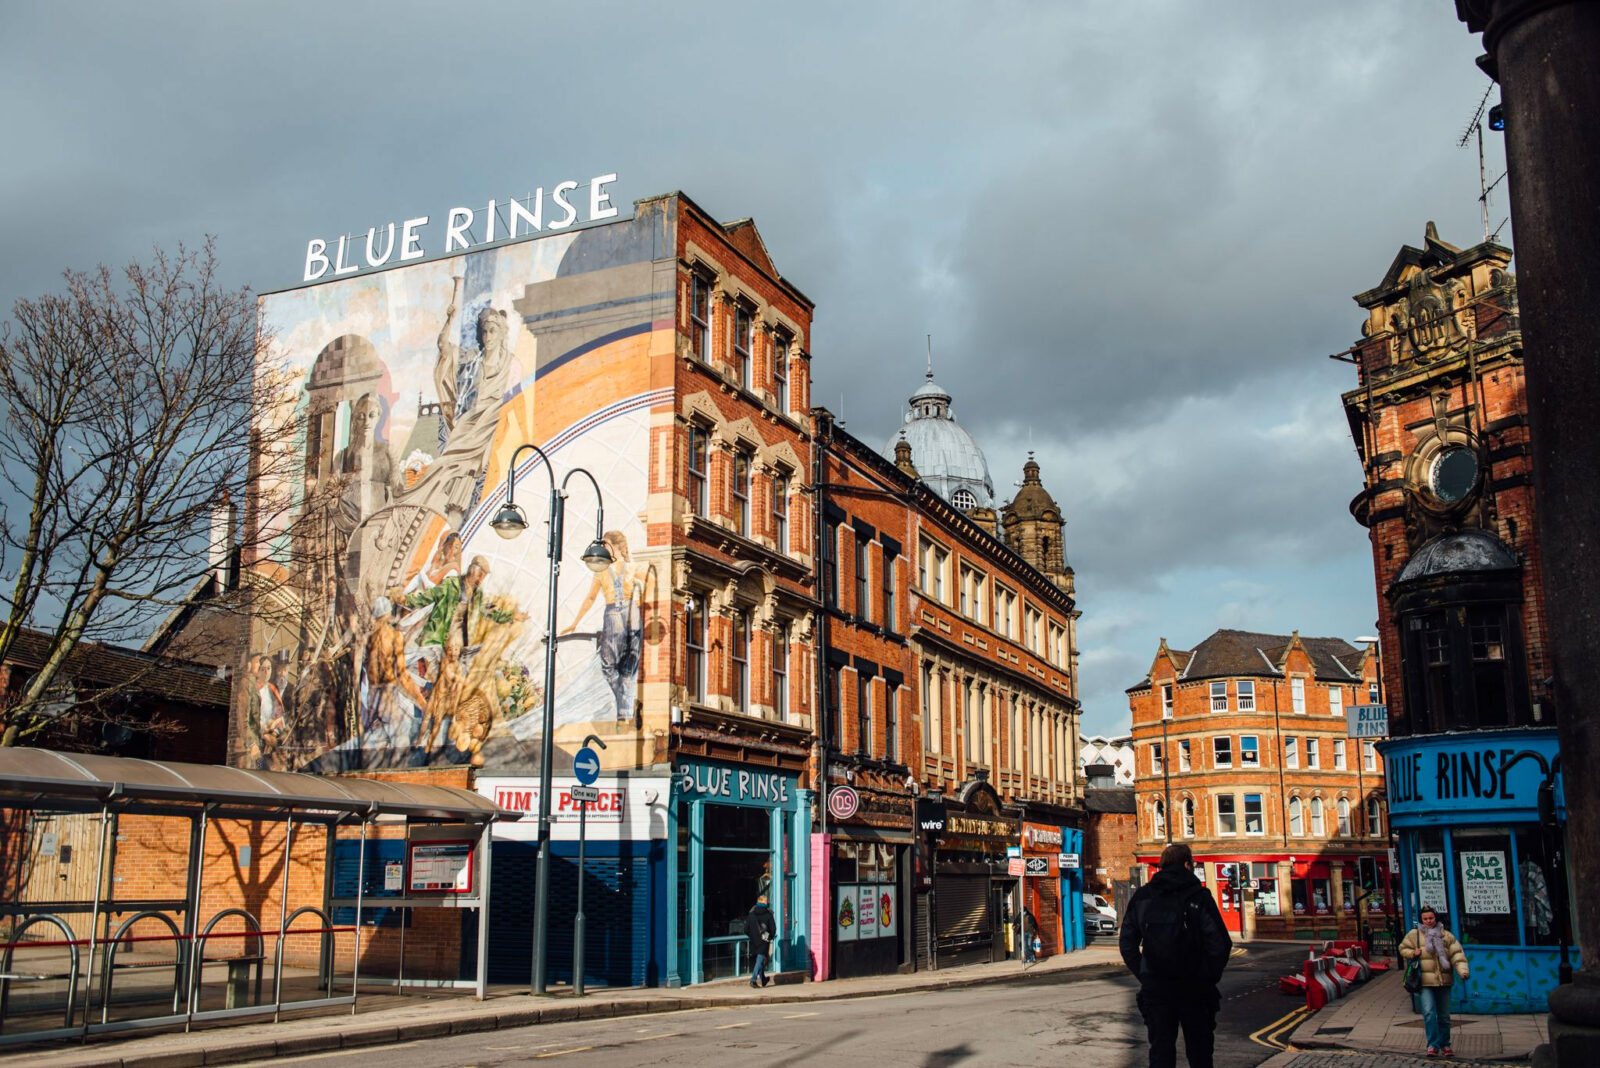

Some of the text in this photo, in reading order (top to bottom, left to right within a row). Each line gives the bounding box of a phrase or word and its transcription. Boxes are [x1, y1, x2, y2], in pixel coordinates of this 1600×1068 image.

[303, 173, 618, 282] BLUE RINSE
[1358, 707, 1388, 720] BLUE
[1356, 722, 1386, 736] RINS
[680, 764, 788, 802] BLUE RINSE
[1389, 749, 1515, 804] BLUE RINSE
[498, 791, 539, 811] JIM'
[574, 789, 597, 800] One way
[1419, 857, 1440, 869] KILO
[1466, 855, 1500, 868] KILO
[1420, 869, 1443, 881] SALE
[1466, 868, 1503, 881] SALE
